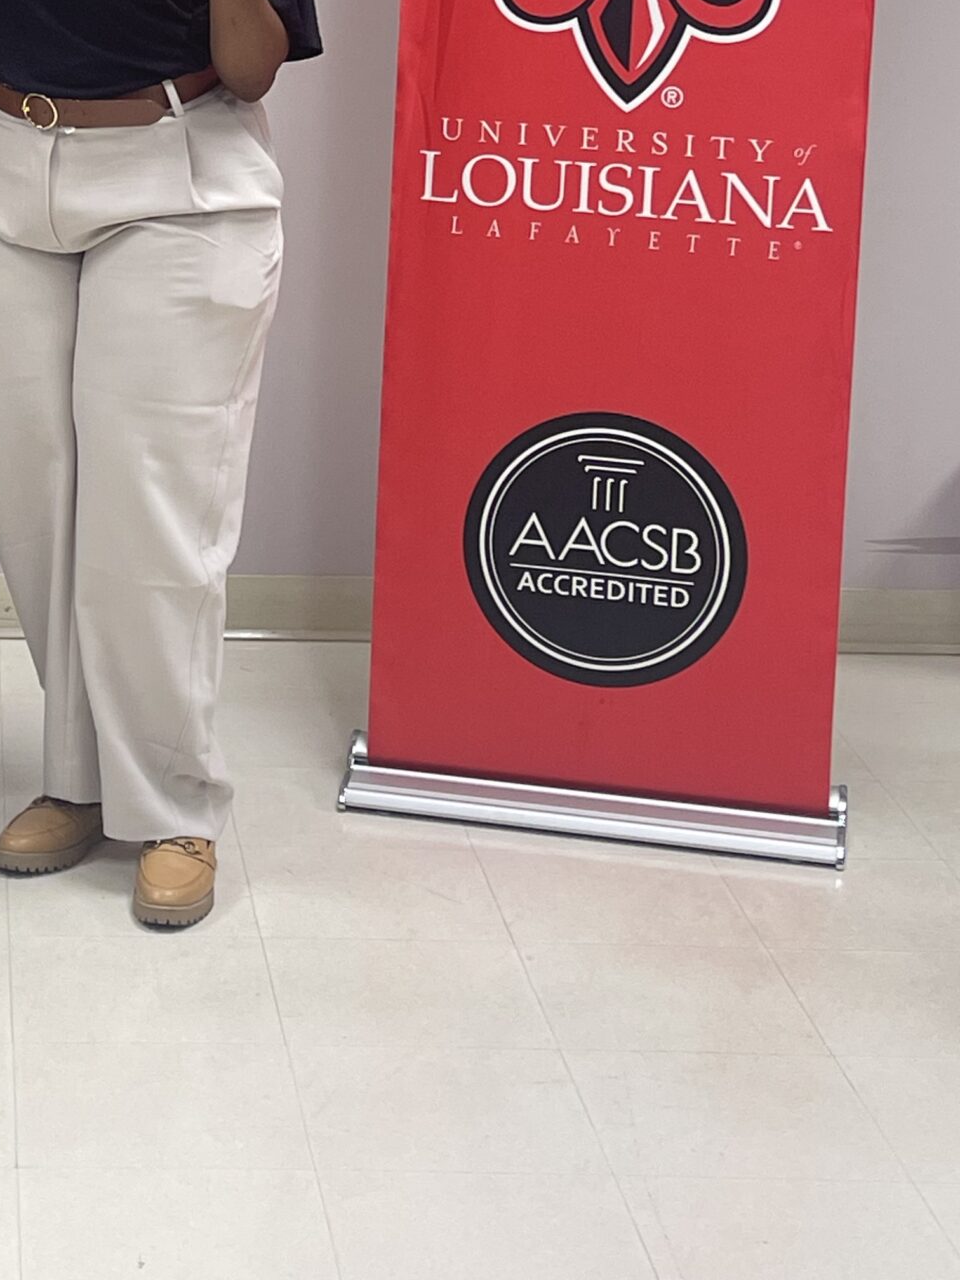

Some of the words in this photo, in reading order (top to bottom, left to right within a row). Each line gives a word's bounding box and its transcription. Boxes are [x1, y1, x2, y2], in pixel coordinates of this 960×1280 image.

[440, 117, 773, 163] UNIVERSITY
[793, 144, 817, 165] of
[419, 150, 834, 233] LOUISIANA
[508, 511, 702, 575] AACSB
[516, 571, 691, 609] ACCREDITED
